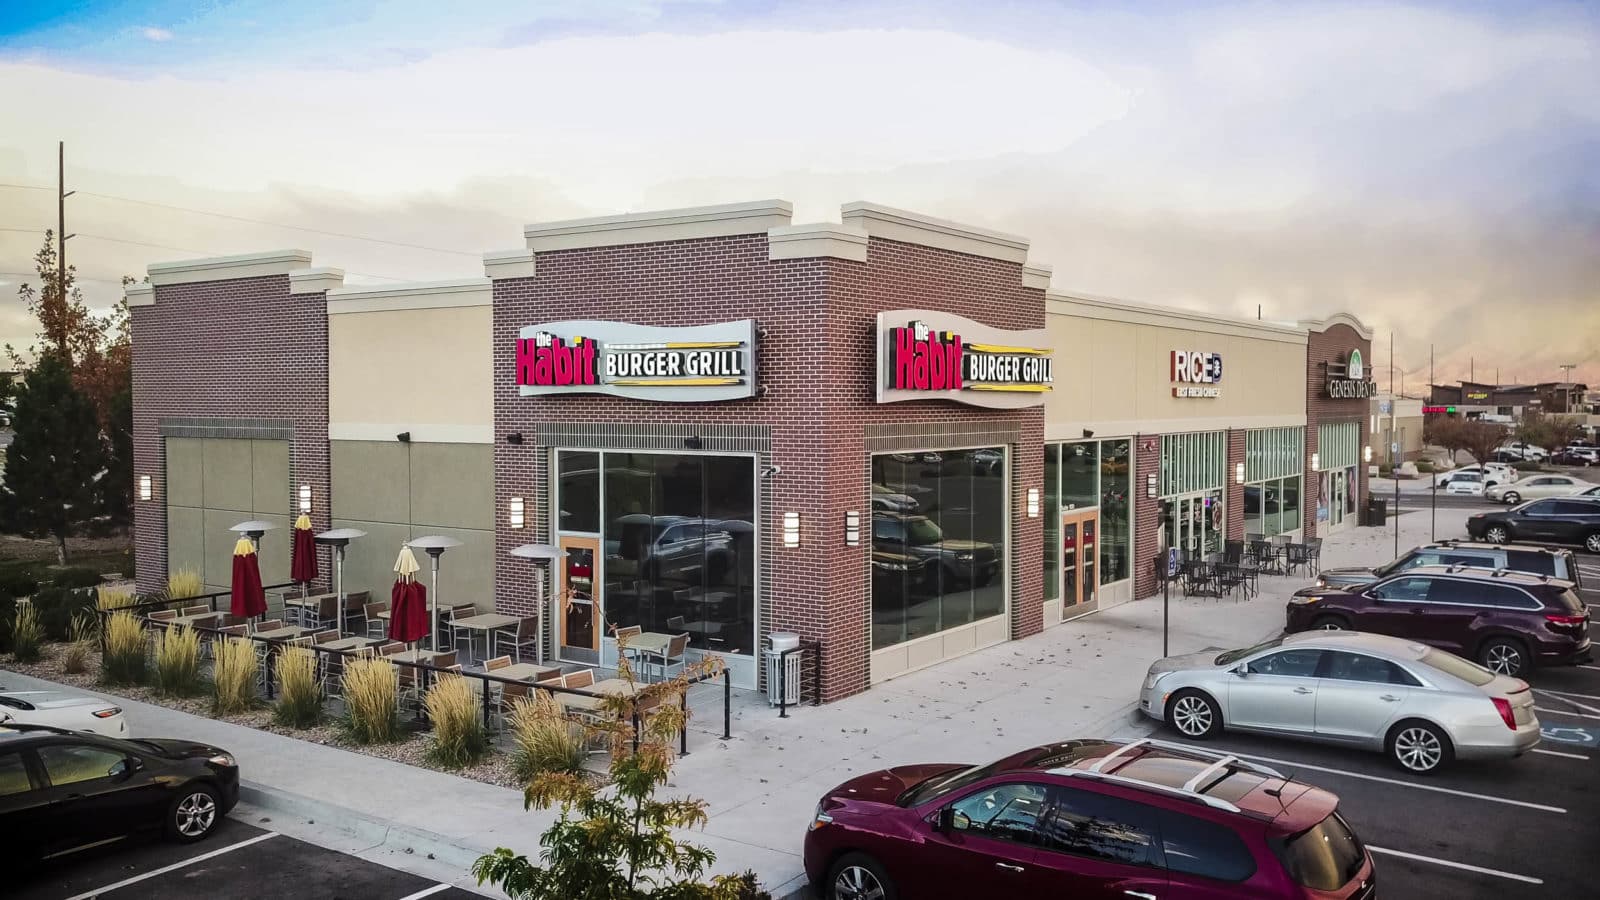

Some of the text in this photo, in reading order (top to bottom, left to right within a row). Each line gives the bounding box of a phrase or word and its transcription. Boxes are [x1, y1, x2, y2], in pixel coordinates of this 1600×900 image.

[537, 331, 551, 346] the
[914, 322, 929, 341] the
[516, 337, 595, 386] Habit
[606, 350, 743, 377] BURGER GRILL
[896, 327, 963, 390] Habit
[970, 355, 1053, 382] BURGER GRILL
[1175, 350, 1213, 383] RICE
[1330, 379, 1356, 398] GENESIS
